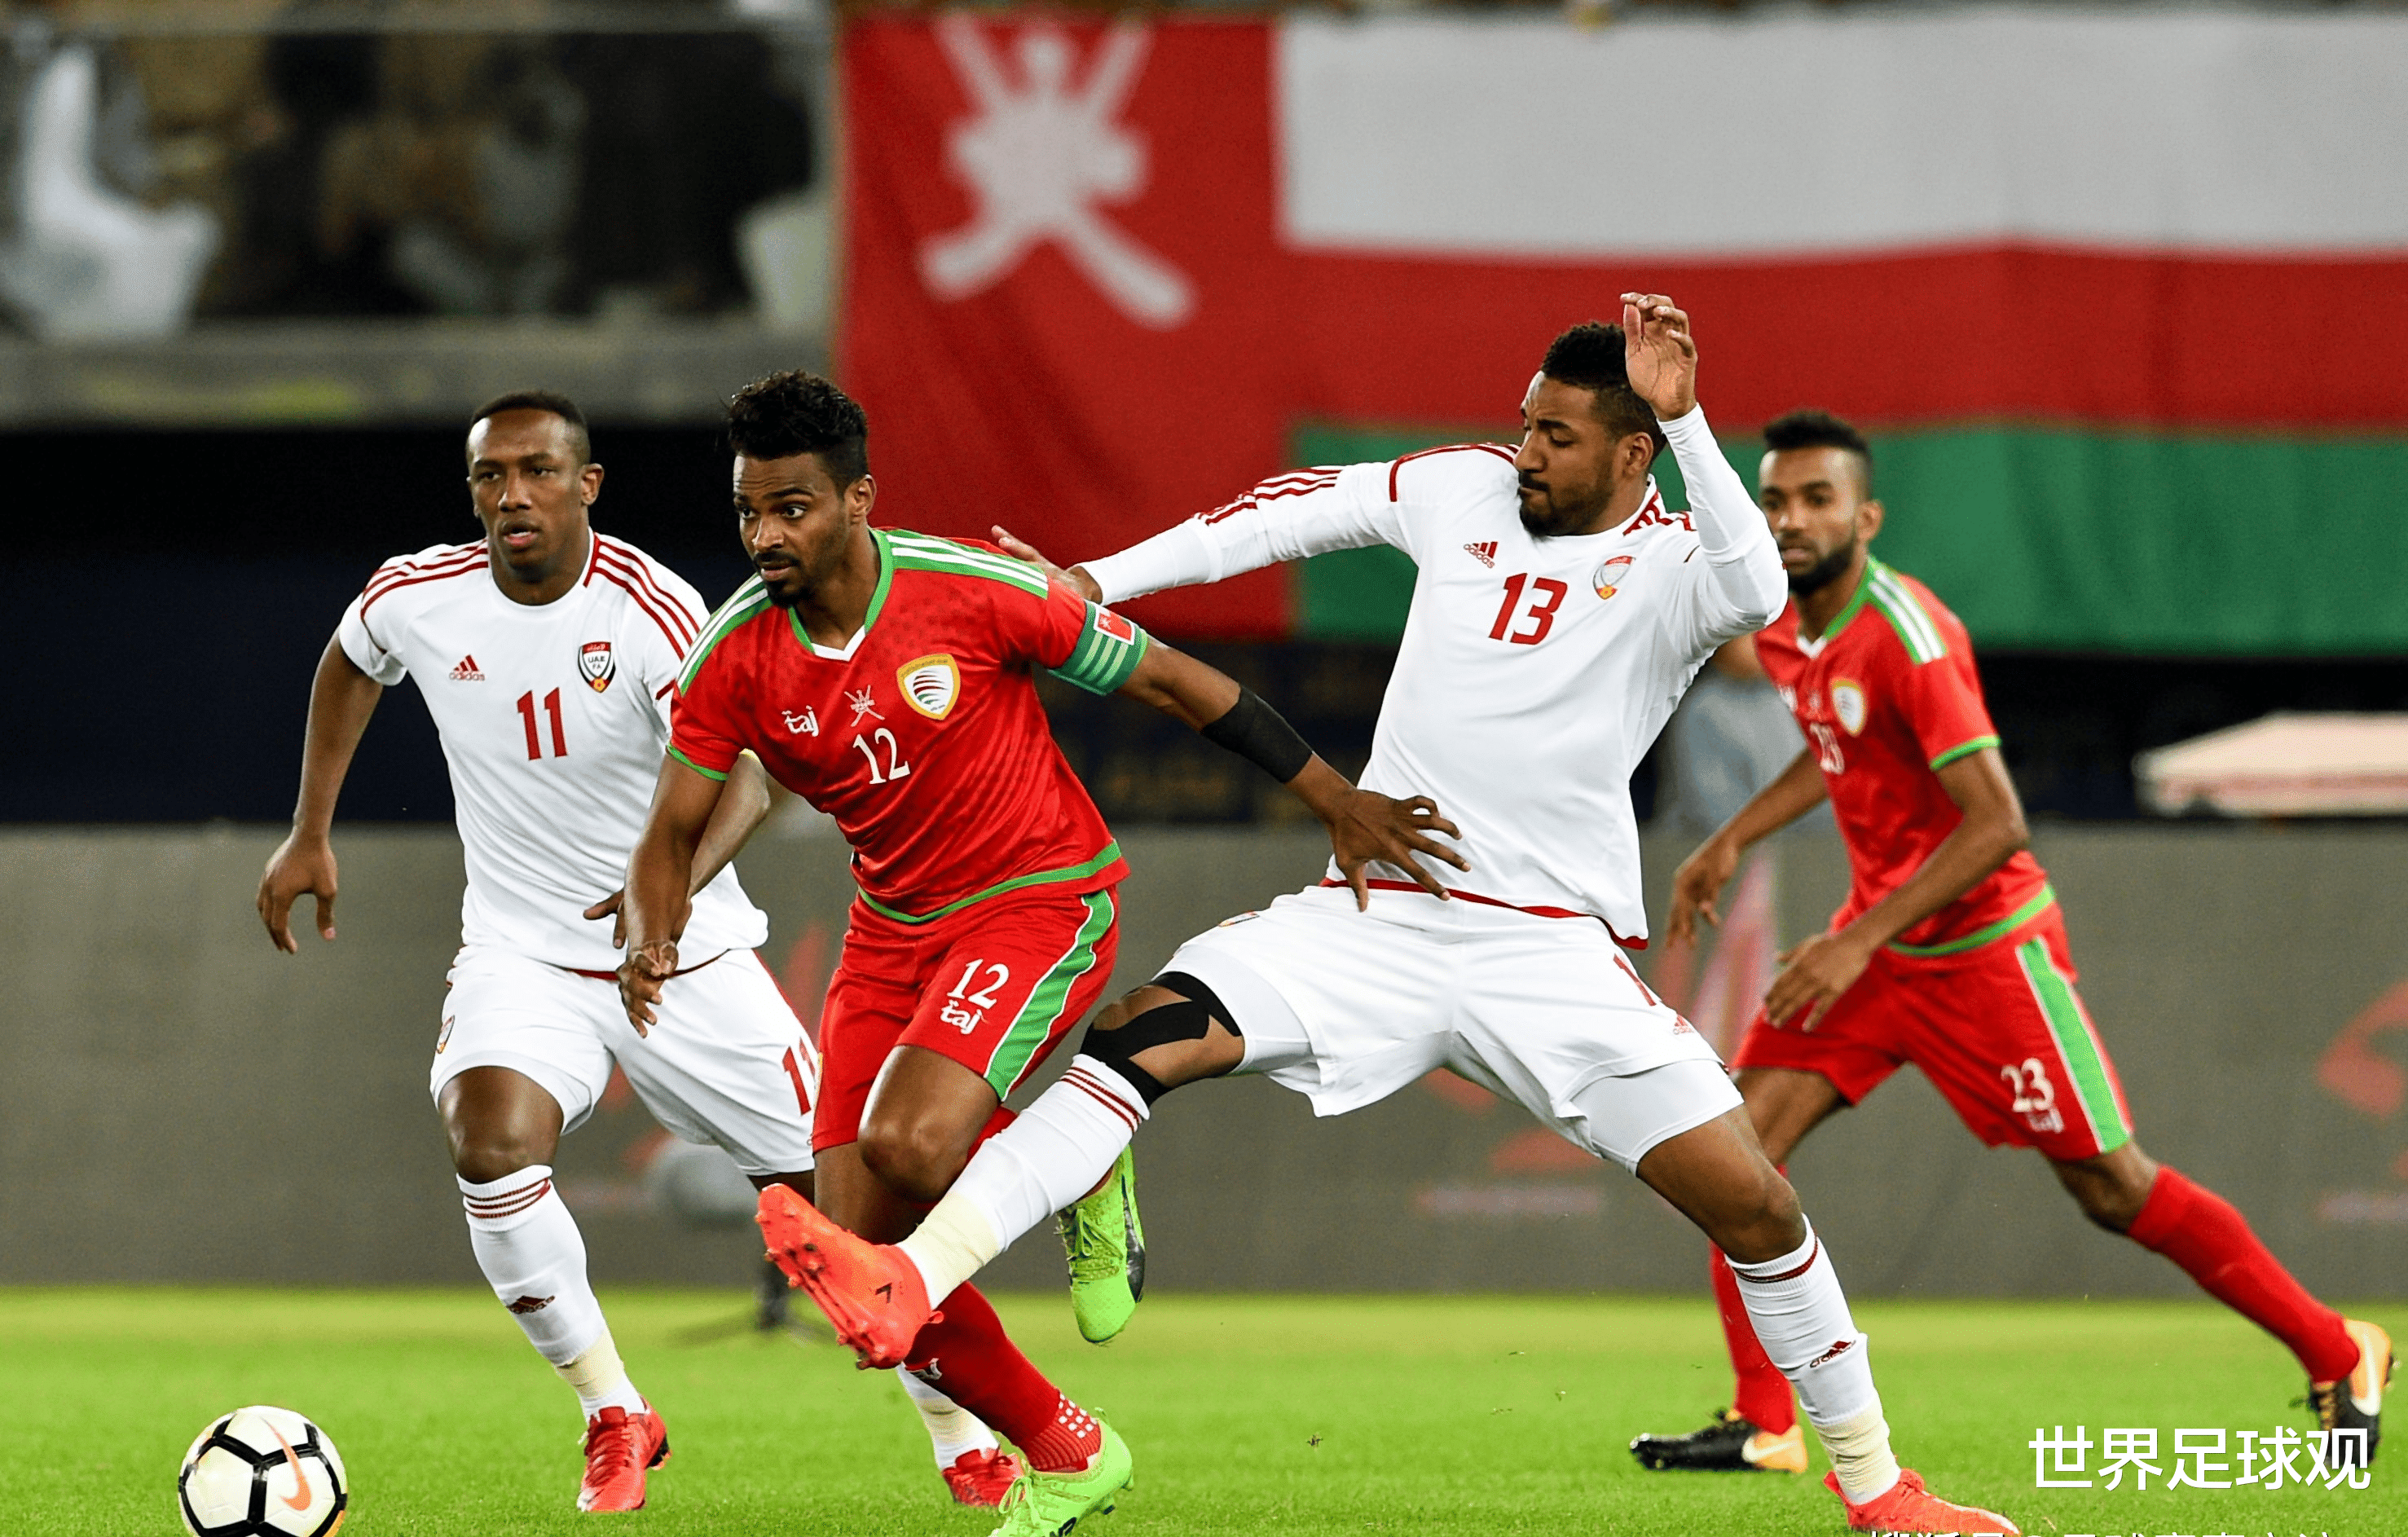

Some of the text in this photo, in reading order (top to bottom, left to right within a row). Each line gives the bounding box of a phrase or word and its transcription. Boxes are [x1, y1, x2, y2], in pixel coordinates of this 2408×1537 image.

[1464, 544, 1495, 568] adidas
[1489, 572, 1568, 645] 13
[449, 672, 486, 681] adidas
[588, 655, 605, 663] UAE
[517, 687, 568, 760] 11
[781, 704, 820, 738] taj
[852, 728, 911, 785] 12
[947, 958, 1010, 1010] 12
[940, 999, 983, 1035] taj
[2001, 1058, 2055, 1112] 23
